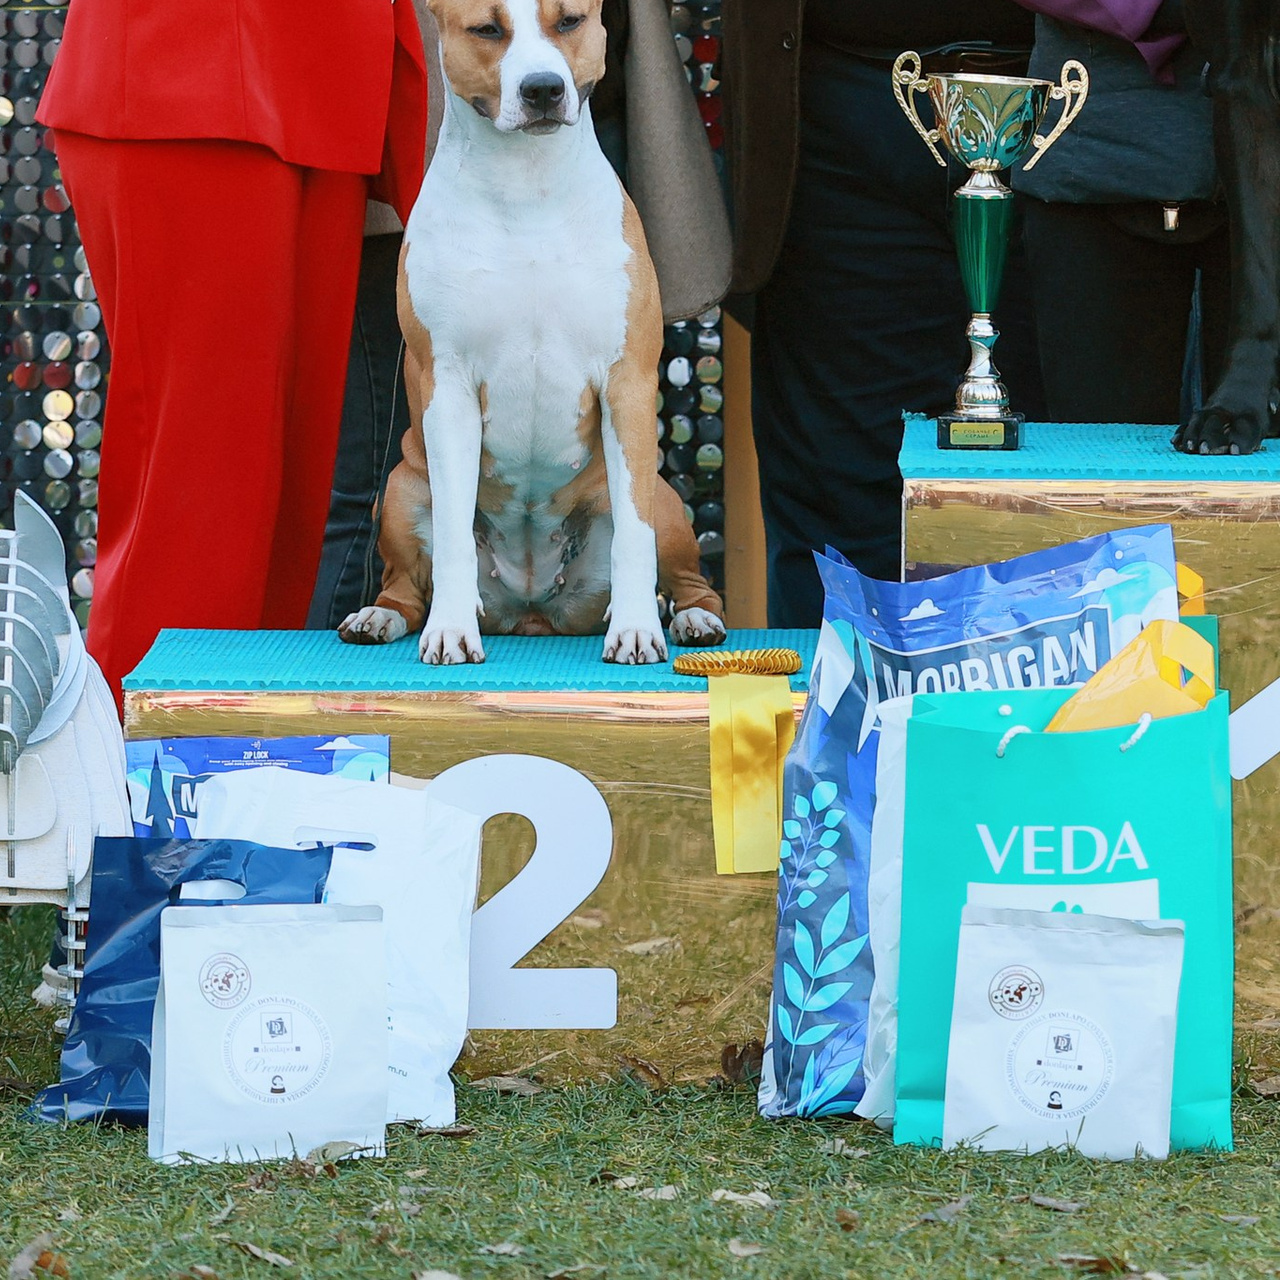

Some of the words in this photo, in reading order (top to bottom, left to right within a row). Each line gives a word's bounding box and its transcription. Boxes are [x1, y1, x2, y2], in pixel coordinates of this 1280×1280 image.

[243, 751, 253, 759] ZIP
[253, 751, 269, 759] LOCK
[975, 820, 1149, 875] VEDA
[428, 753, 618, 1030] 2
[258, 996, 297, 1006] DONLAPO
[1049, 1011, 1087, 1024] DONLAPO
[245, 1057, 310, 1073] Premium
[1024, 1069, 1088, 1092] Premium
